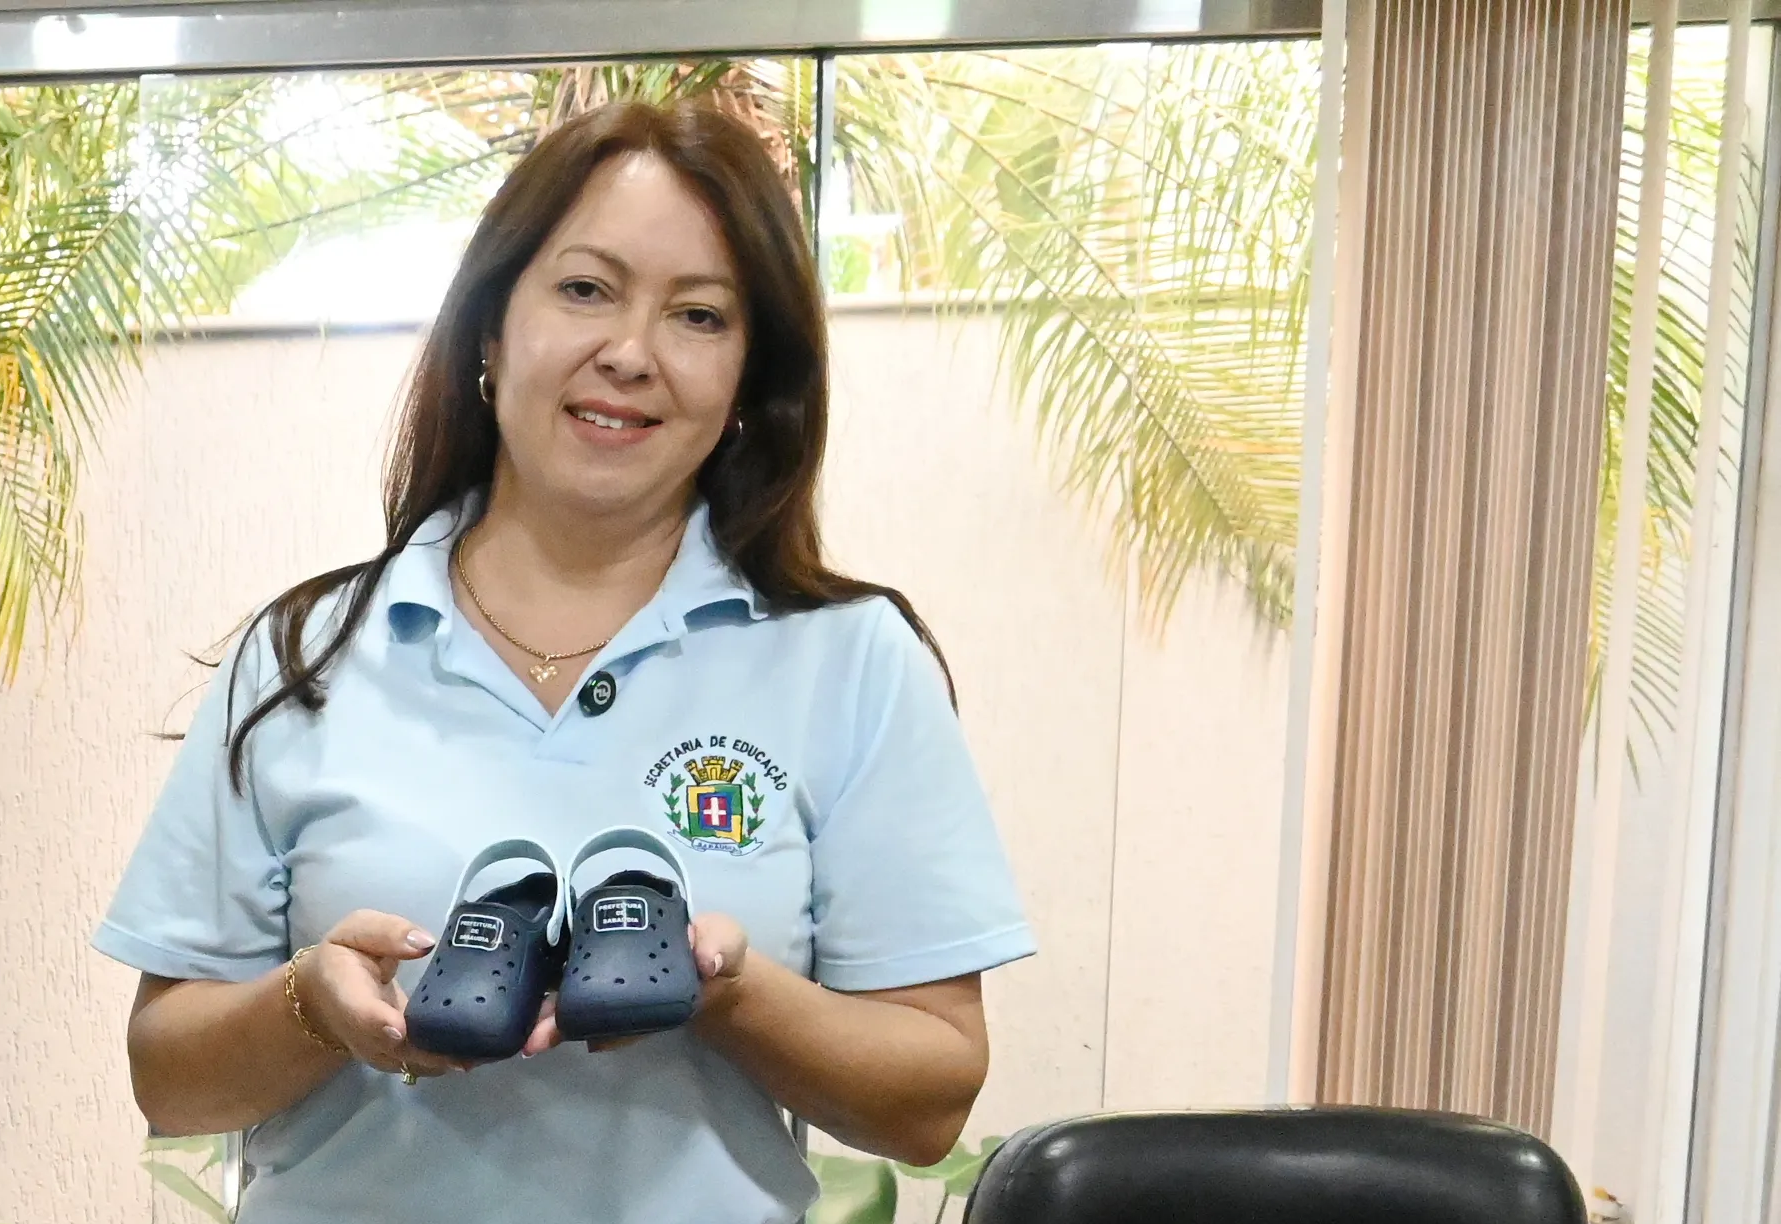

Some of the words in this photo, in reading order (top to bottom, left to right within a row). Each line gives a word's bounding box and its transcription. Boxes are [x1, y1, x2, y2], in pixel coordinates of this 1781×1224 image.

[643, 738, 703, 788] SECRETARIA
[709, 735, 727, 748] DE
[732, 739, 788, 791] EDUCAÇÃO
